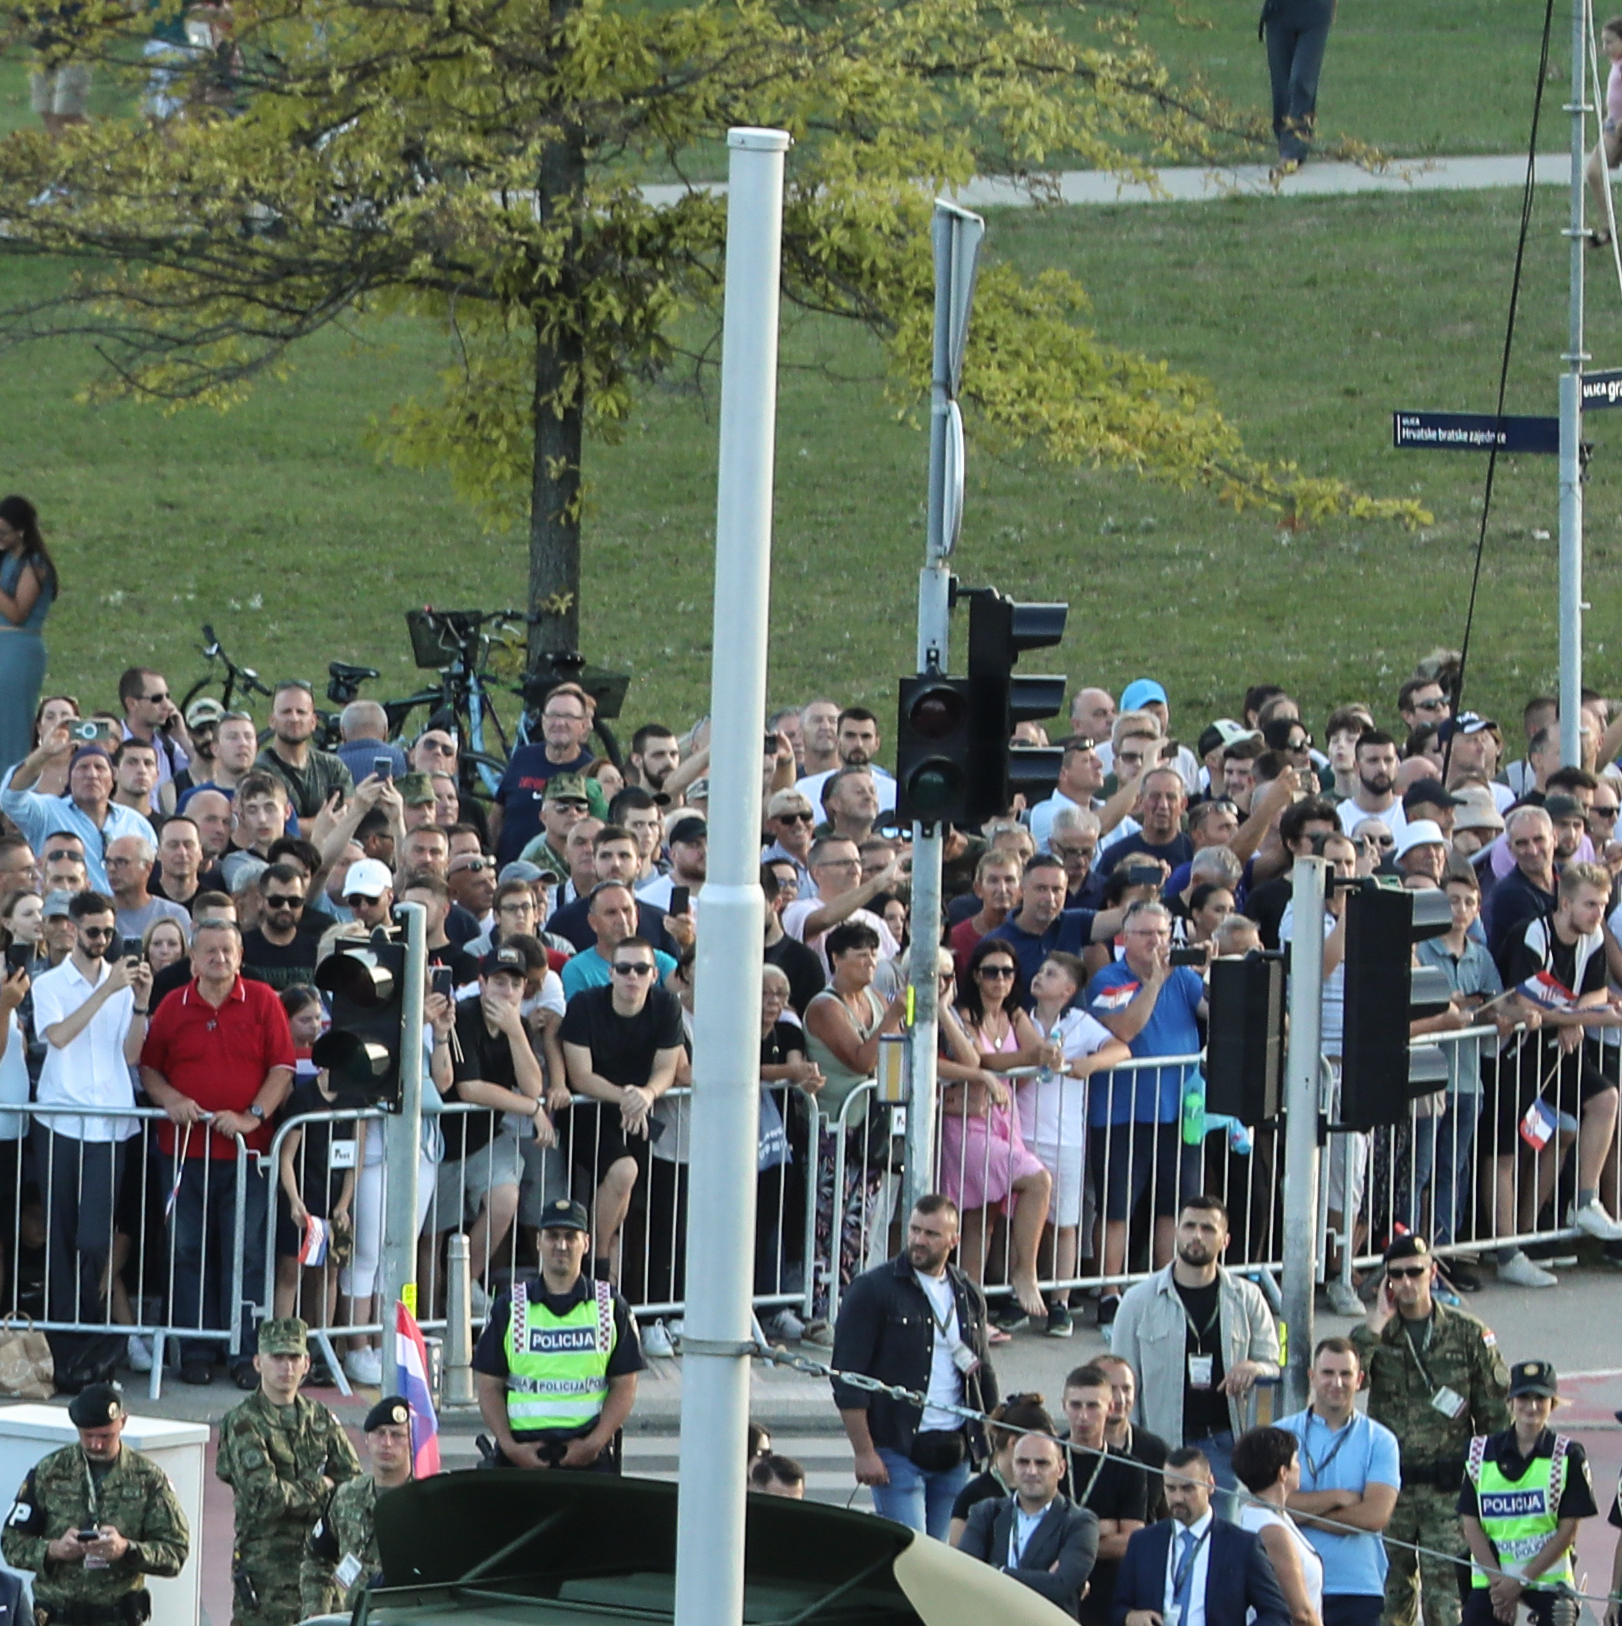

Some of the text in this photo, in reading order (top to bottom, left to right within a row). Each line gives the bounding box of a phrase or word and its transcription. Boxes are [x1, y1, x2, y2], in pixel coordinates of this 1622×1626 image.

[1583, 382, 1607, 398] ULICA
[1402, 427, 1507, 446] Hrvatske bratske zajednce
[531, 1332, 595, 1349] POLICIJA
[539, 1381, 585, 1392] POLICIJA
[1482, 1494, 1542, 1513] POLICIJA
